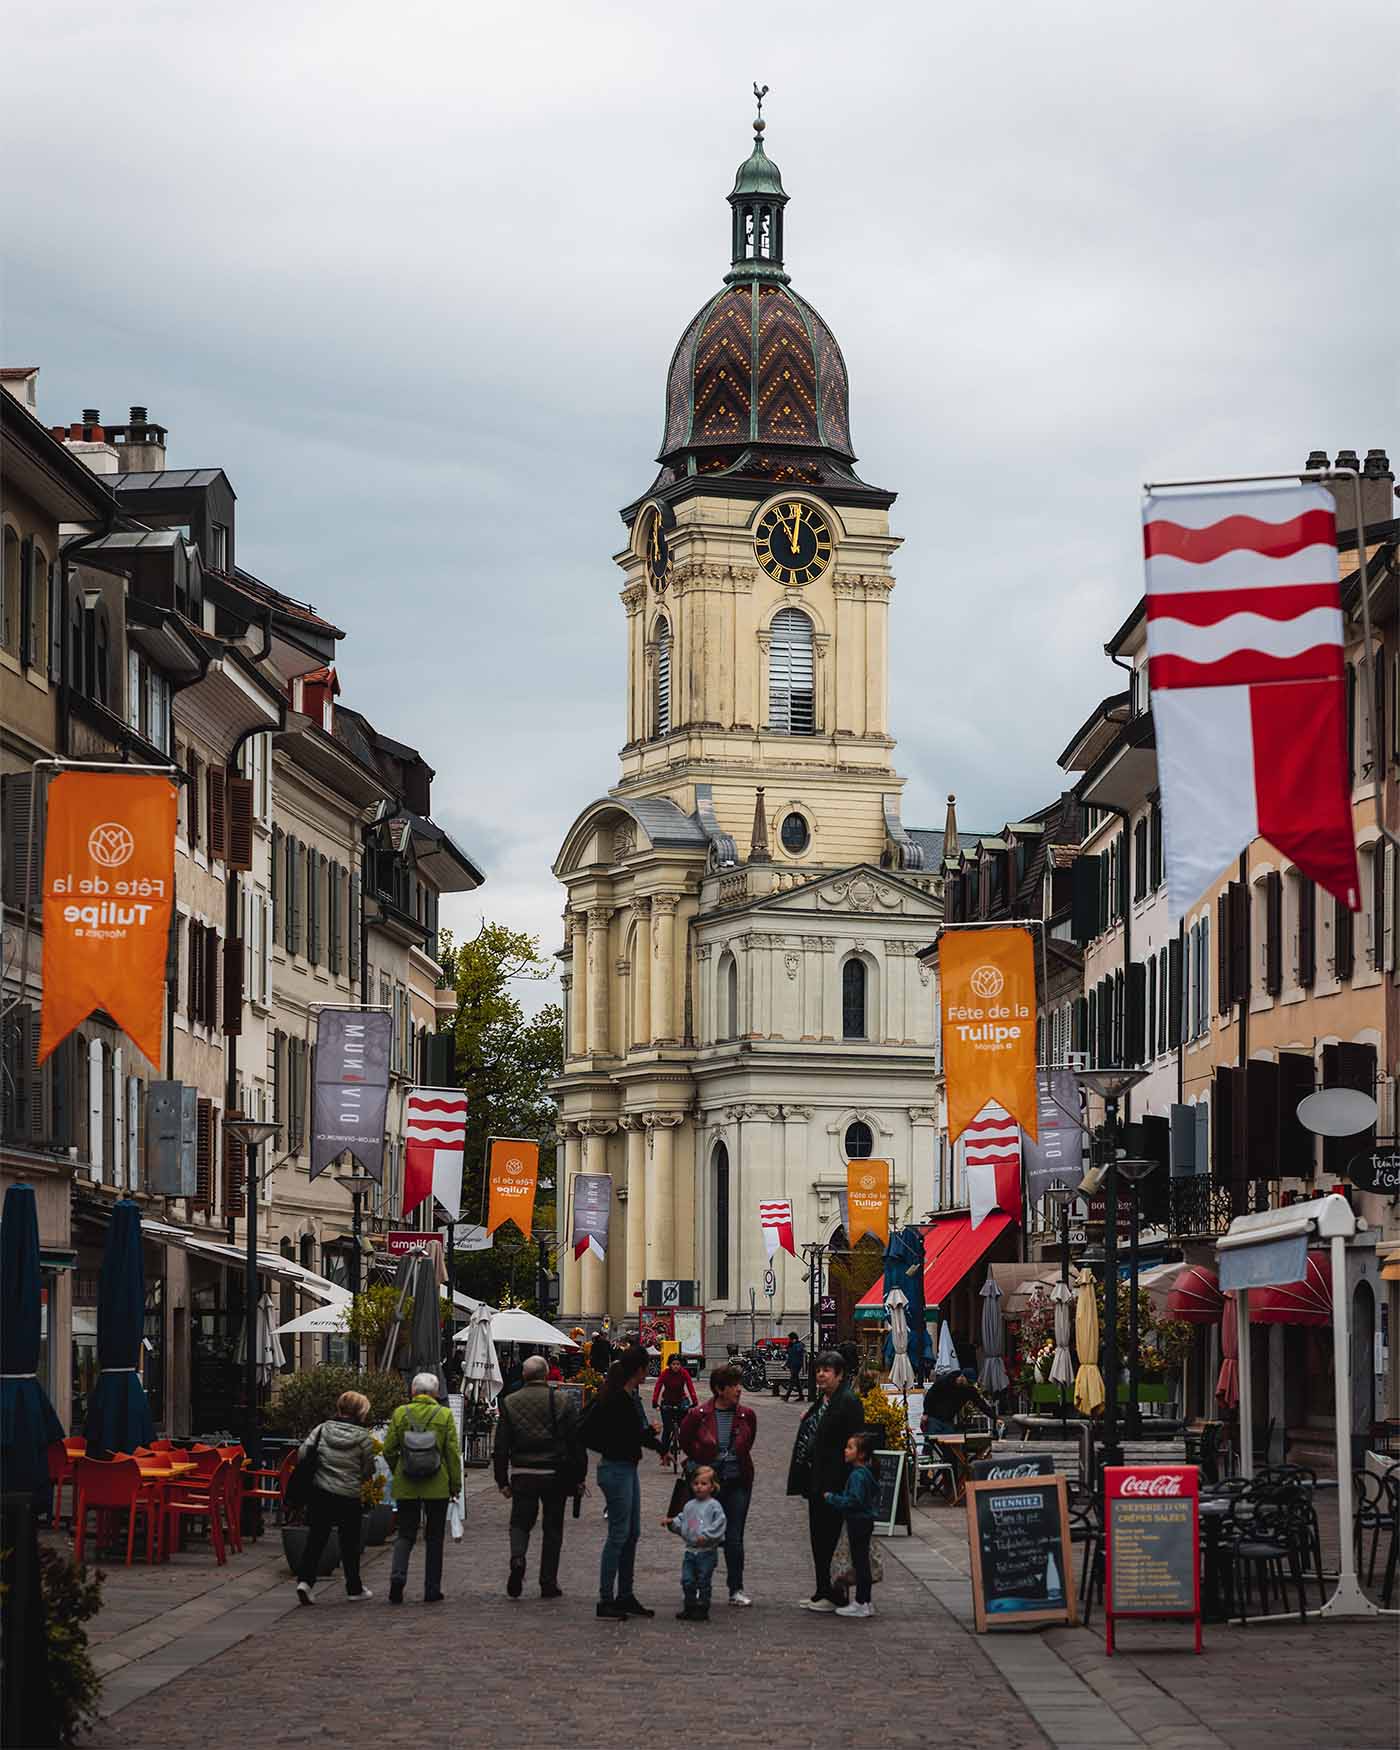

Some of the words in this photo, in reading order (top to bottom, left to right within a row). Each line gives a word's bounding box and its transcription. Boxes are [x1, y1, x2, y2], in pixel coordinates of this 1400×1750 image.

[947, 1006, 984, 1021] Fête
[988, 1004, 1010, 1019] de
[1015, 1003, 1029, 1017] la
[956, 1024, 1021, 1043] Tulipe
[391, 1239, 427, 1250] amplif
[1120, 1475, 1183, 1496] Coca-Cola
[993, 1496, 1040, 1508] HENNIEZ
